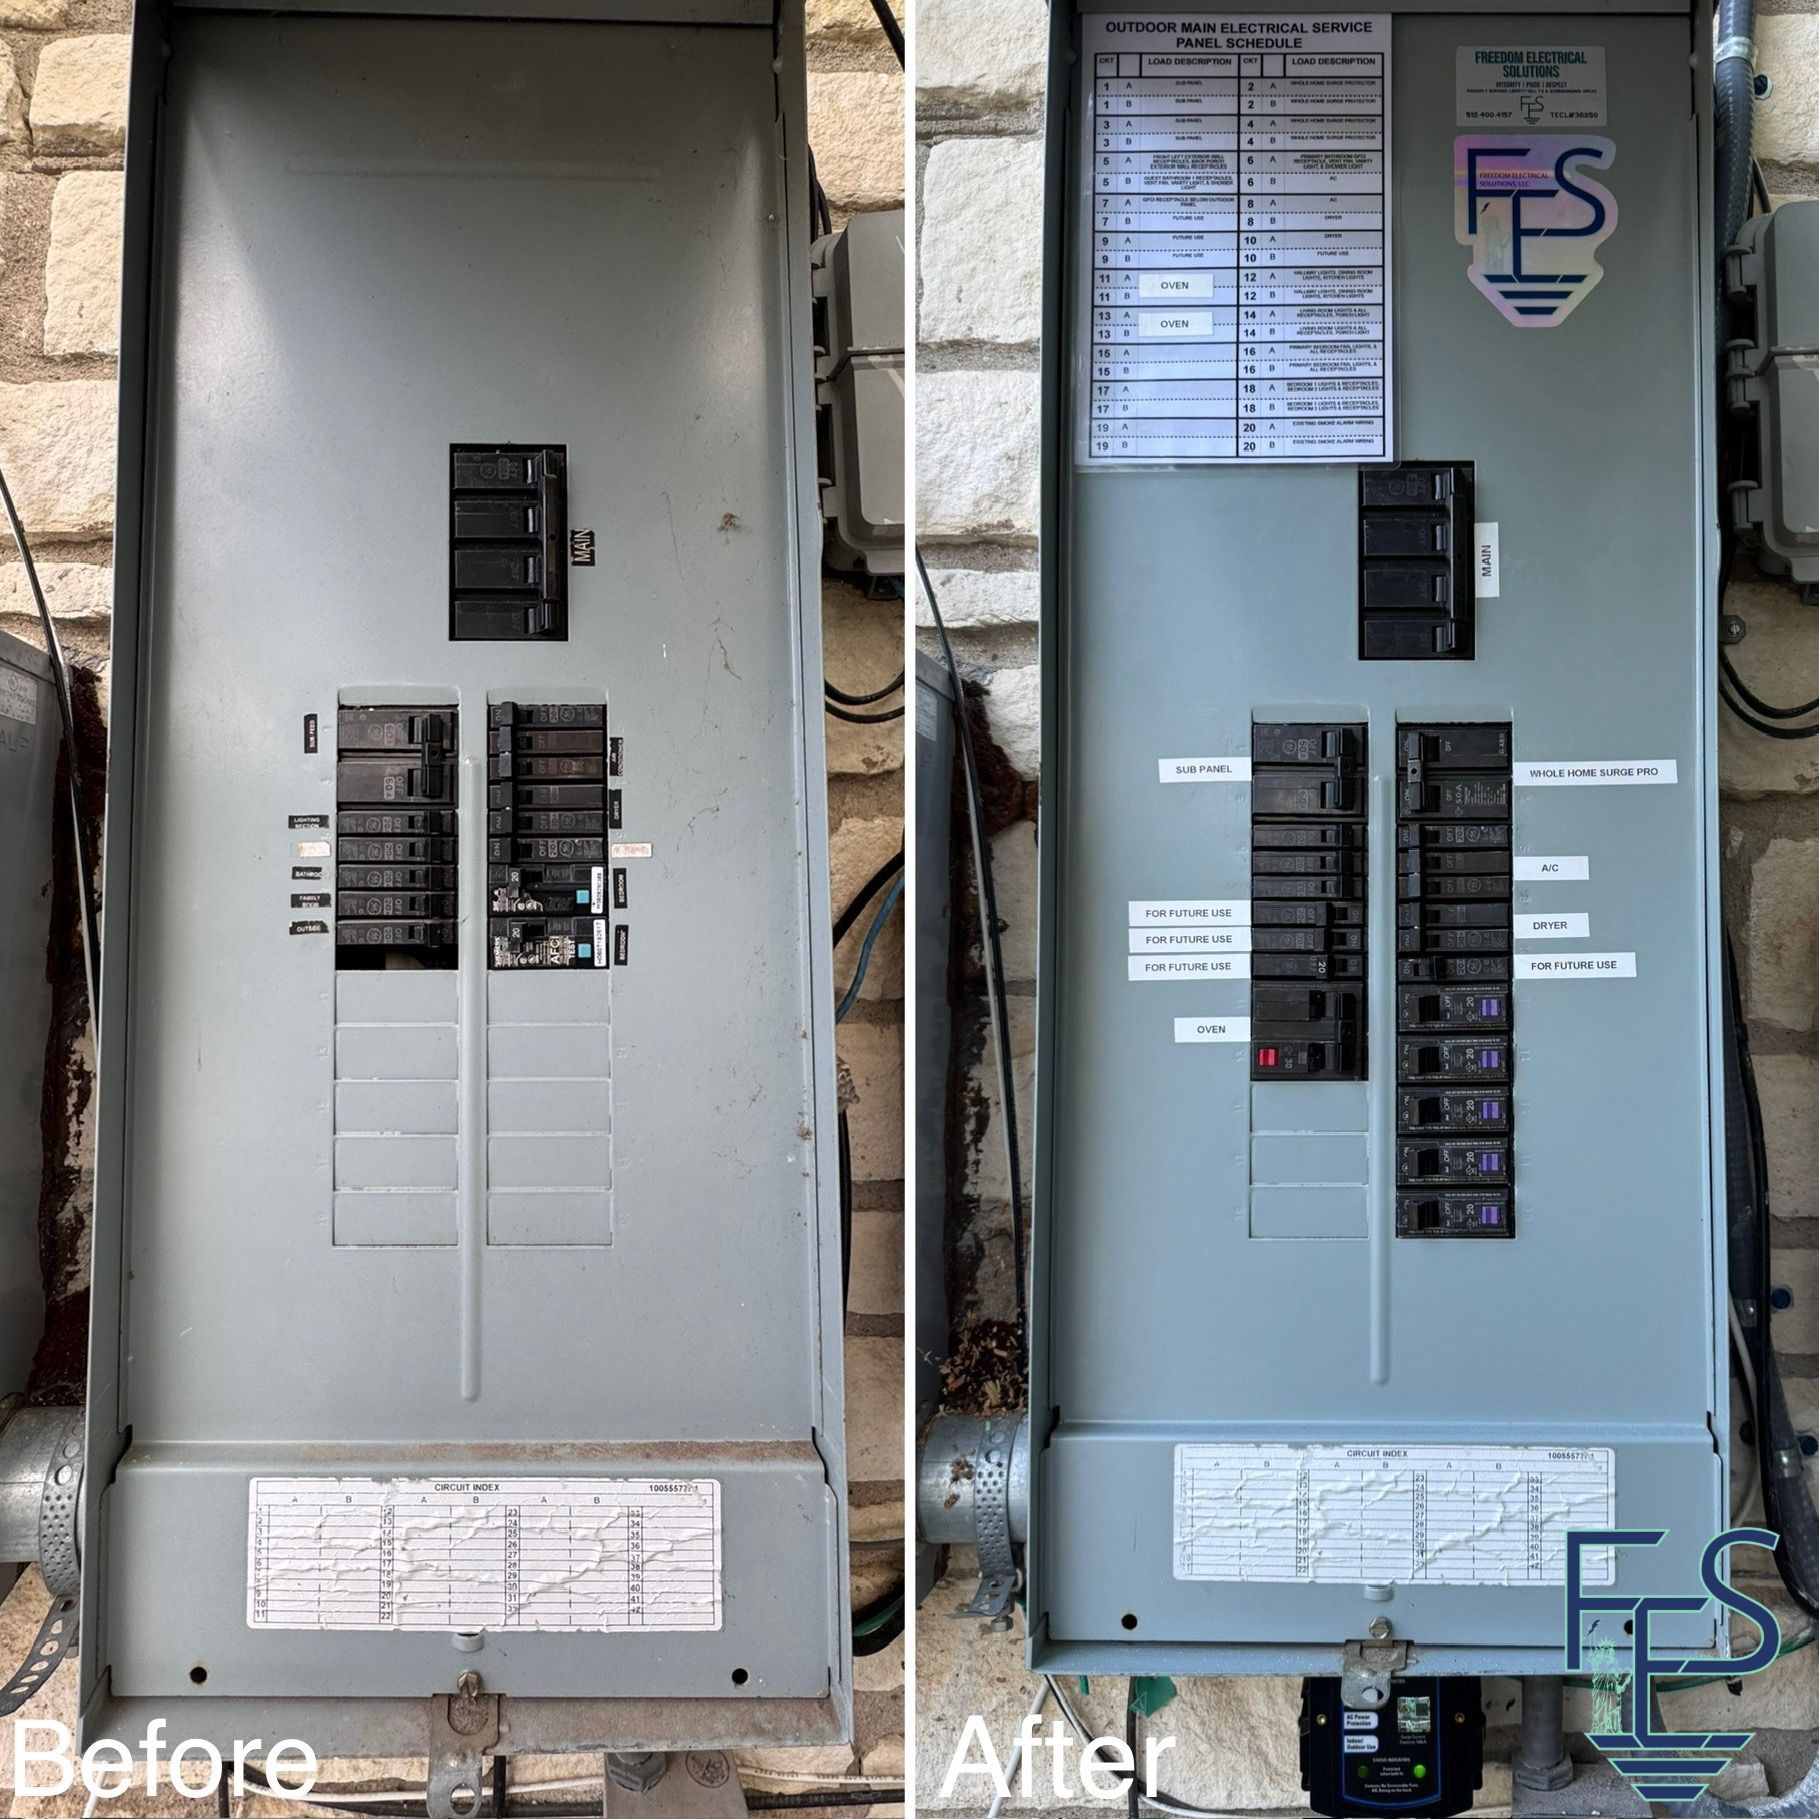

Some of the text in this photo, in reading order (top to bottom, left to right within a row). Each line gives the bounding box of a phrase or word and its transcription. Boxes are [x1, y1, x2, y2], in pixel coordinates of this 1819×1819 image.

[1105, 22, 1373, 34] OUTDOOR MAIN ELECTRICAL SERVICE
[1176, 38, 1303, 49] PANEL SCHEDULE
[1148, 57, 1232, 66] LOAD DESCRIPTION
[1292, 57, 1376, 66] LOAD DESCRIPTION
[1475, 51, 1587, 64] FREEDOM ELECTRICAL
[1503, 65, 1560, 78] SOLUTIONS
[1104, 82, 1109, 91] 1
[1247, 82, 1254, 91] 2
[1104, 101, 1109, 109] 1
[1247, 101, 1254, 109] 2
[1103, 120, 1110, 129] 3
[1247, 120, 1254, 128] 4
[1103, 138, 1110, 147] 3
[1247, 137, 1254, 146] 4
[1103, 157, 1110, 166] 5
[1247, 156, 1254, 165] 6
[1103, 177, 1110, 187] 5
[1247, 177, 1254, 187] 6
[1102, 199, 1109, 208] 7
[1247, 199, 1254, 208] 8
[1467, 147, 1606, 283] FES
[1102, 217, 1109, 226] 7
[1247, 217, 1254, 226] 8
[1102, 237, 1109, 246] 9
[1244, 236, 1257, 245] 10
[1102, 255, 1109, 264] 9
[1244, 254, 1257, 262] 10
[1099, 274, 1110, 283] 11
[1244, 273, 1257, 282] 12
[1161, 281, 1190, 290] OVEN
[1099, 292, 1110, 302] 11
[1244, 291, 1257, 301] 12
[1098, 311, 1111, 321] 13
[1243, 310, 1256, 320] 14
[1160, 320, 1189, 328] OVEN
[1098, 329, 1111, 339] 13
[1243, 328, 1256, 338] 14
[1098, 349, 1111, 358] 15
[1243, 347, 1256, 356] 16
[1097, 367, 1110, 376] 15
[1243, 365, 1256, 374] 16
[1097, 386, 1110, 396] 17
[1243, 384, 1256, 393] 18
[1097, 405, 1109, 414] 17
[1243, 404, 1256, 413] 18
[1096, 423, 1109, 433] 19
[1243, 423, 1256, 433] 20
[1096, 441, 1109, 451] 19
[1243, 441, 1256, 451] 20
[574, 528, 591, 562] MAIN
[1481, 544, 1491, 577] MAIN
[1176, 764, 1232, 774] SUB PANEL
[1530, 767, 1659, 778] WHOLE HOME SURGE PRO
[294, 816, 321, 824] LIGHTING
[1541, 864, 1560, 872] A/C
[511, 871, 519, 882] 20
[617, 873, 625, 903] BEDROOM
[1146, 908, 1232, 918] FOR FUTURE USE
[1533, 921, 1568, 930] DRYER
[512, 928, 521, 939] 20
[1146, 935, 1232, 944] FOR FUTURE USE
[549, 935, 561, 966] AFCI
[568, 940, 576, 959] TEST
[1145, 962, 1231, 972] FOR FUTURE USE
[1318, 961, 1326, 974] 20
[1531, 960, 1617, 971] FOR FUTURE USE
[1466, 996, 1475, 1007] 20
[1197, 1024, 1226, 1034] OVEN
[1466, 1048, 1475, 1060] 20
[1284, 1057, 1293, 1069] 30
[1466, 1099, 1475, 1111] 20
[1466, 1151, 1475, 1162] 20
[1466, 1203, 1475, 1215] 20
[434, 1483, 470, 1491] CIRCUIT
[472, 1483, 500, 1491] INDEX
